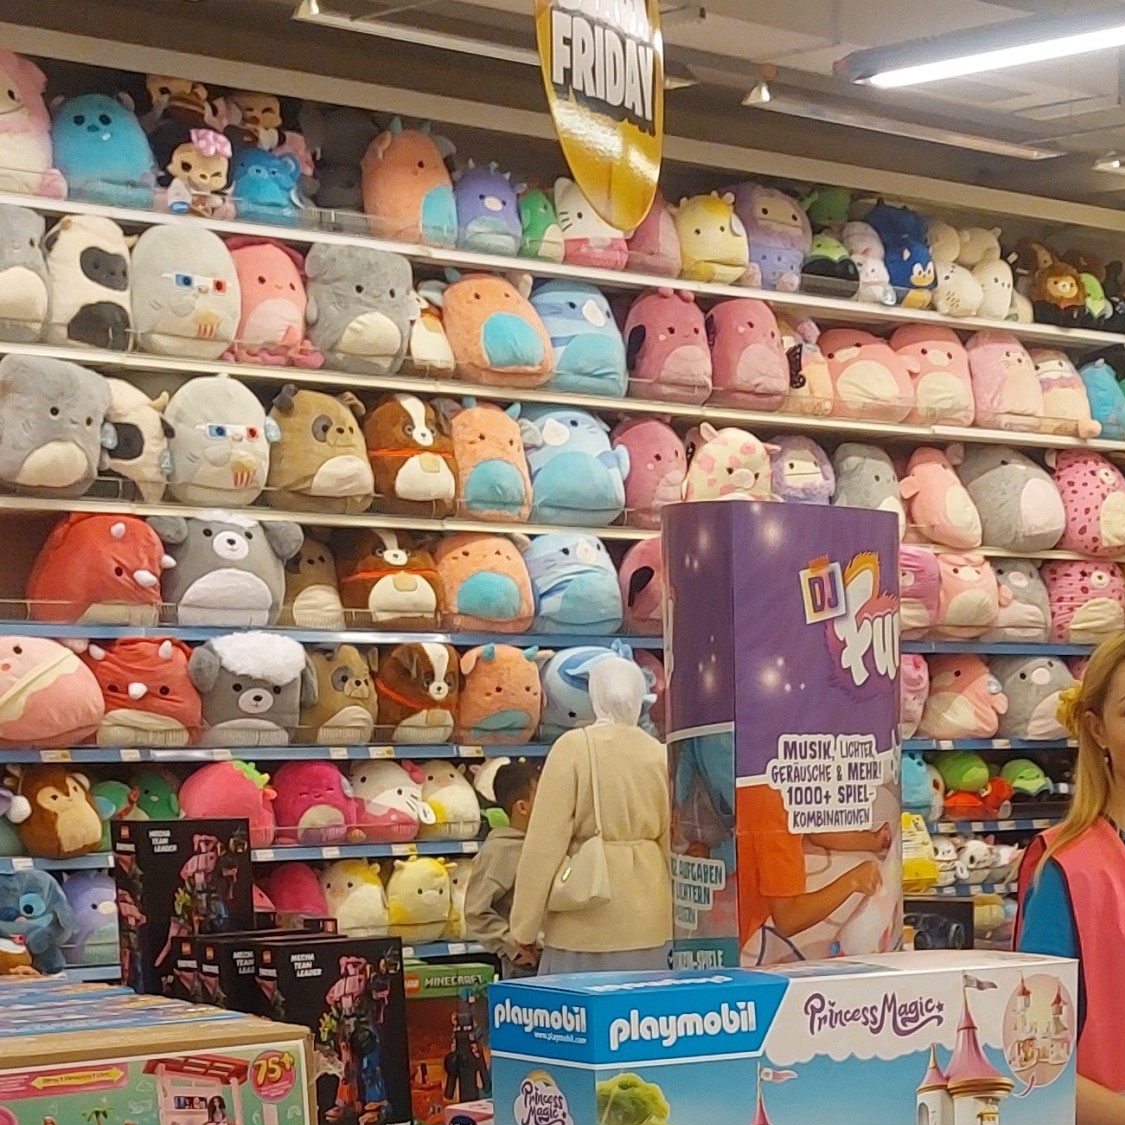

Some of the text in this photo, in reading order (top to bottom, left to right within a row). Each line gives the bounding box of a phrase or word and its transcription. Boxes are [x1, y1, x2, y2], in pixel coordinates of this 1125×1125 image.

[551, 9, 654, 121] FRIDAY
[808, 570, 840, 613] DJ
[783, 740, 835, 761] MUSIK,
[771, 760, 881, 783] GERÄUSCHE & MEHR!
[787, 784, 874, 806] 1000+ SPIEL-
[793, 808, 870, 828] KOMBINATIONEN
[424, 974, 483, 989] MINECRAFT
[494, 998, 587, 1033] playmobil
[610, 1001, 756, 1051] playmobil
[804, 993, 944, 1037] Princess Magic
[254, 1053, 296, 1087] 75+
[522, 1080, 563, 1109] Princess
